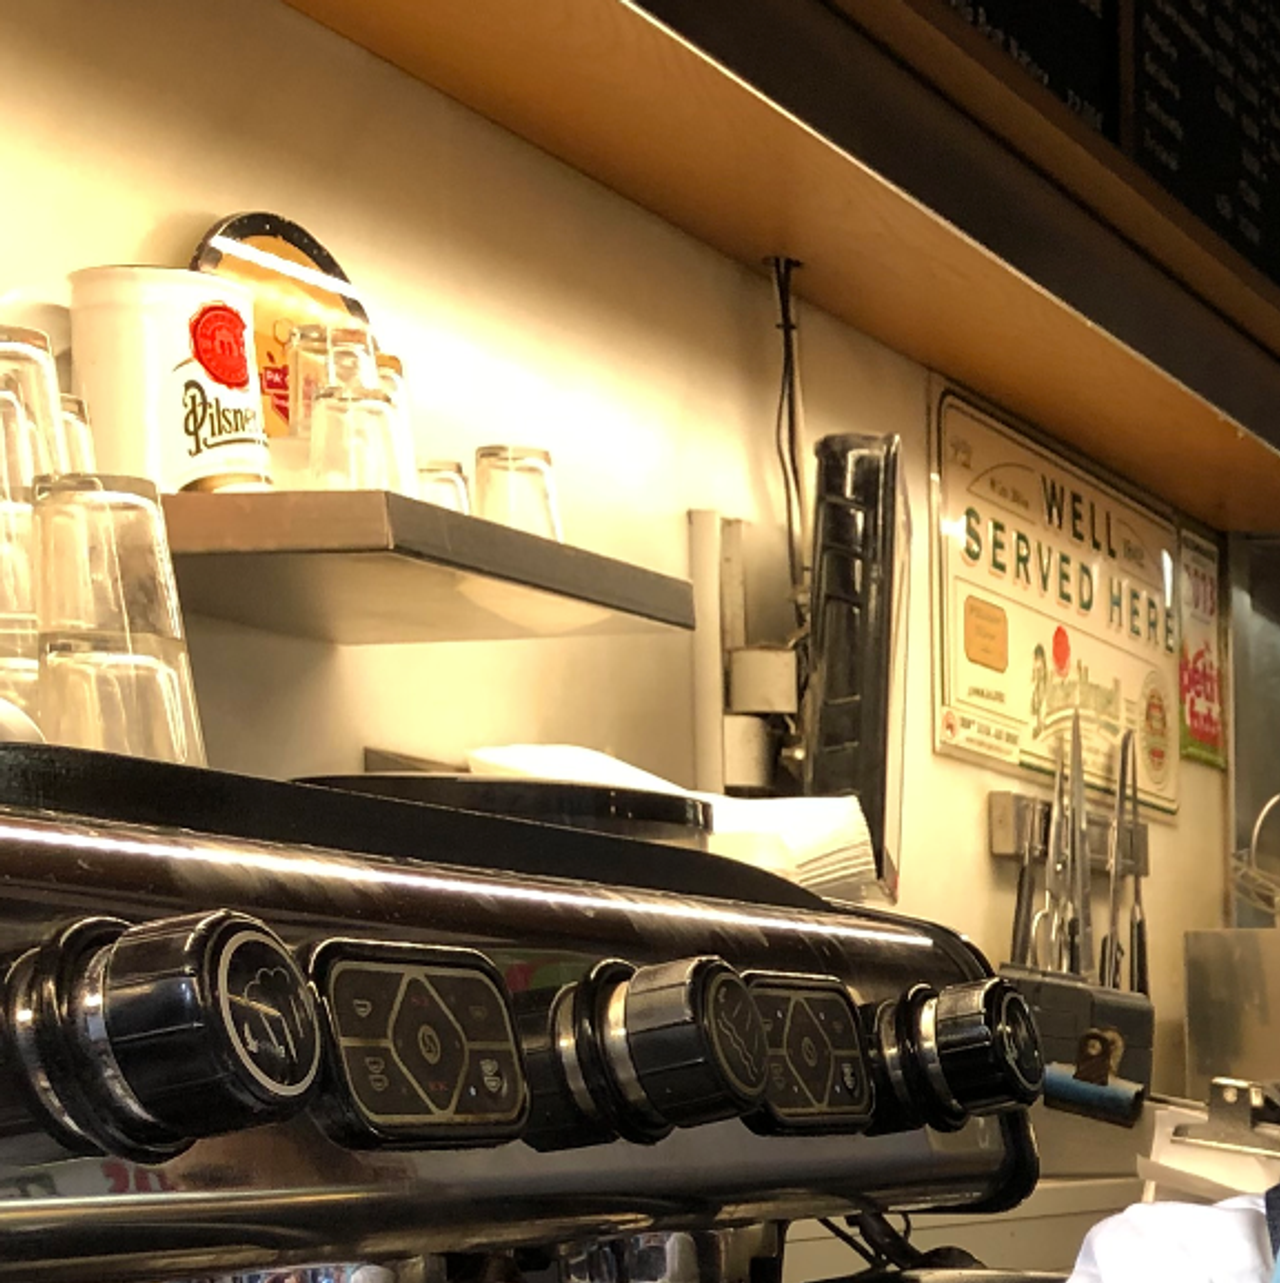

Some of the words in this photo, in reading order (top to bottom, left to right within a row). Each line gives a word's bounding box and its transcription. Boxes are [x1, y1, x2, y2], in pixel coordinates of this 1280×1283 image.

[1040, 473, 1117, 560] WELL
[963, 506, 1095, 614] SERVED
[1108, 575, 1176, 656] HERE
